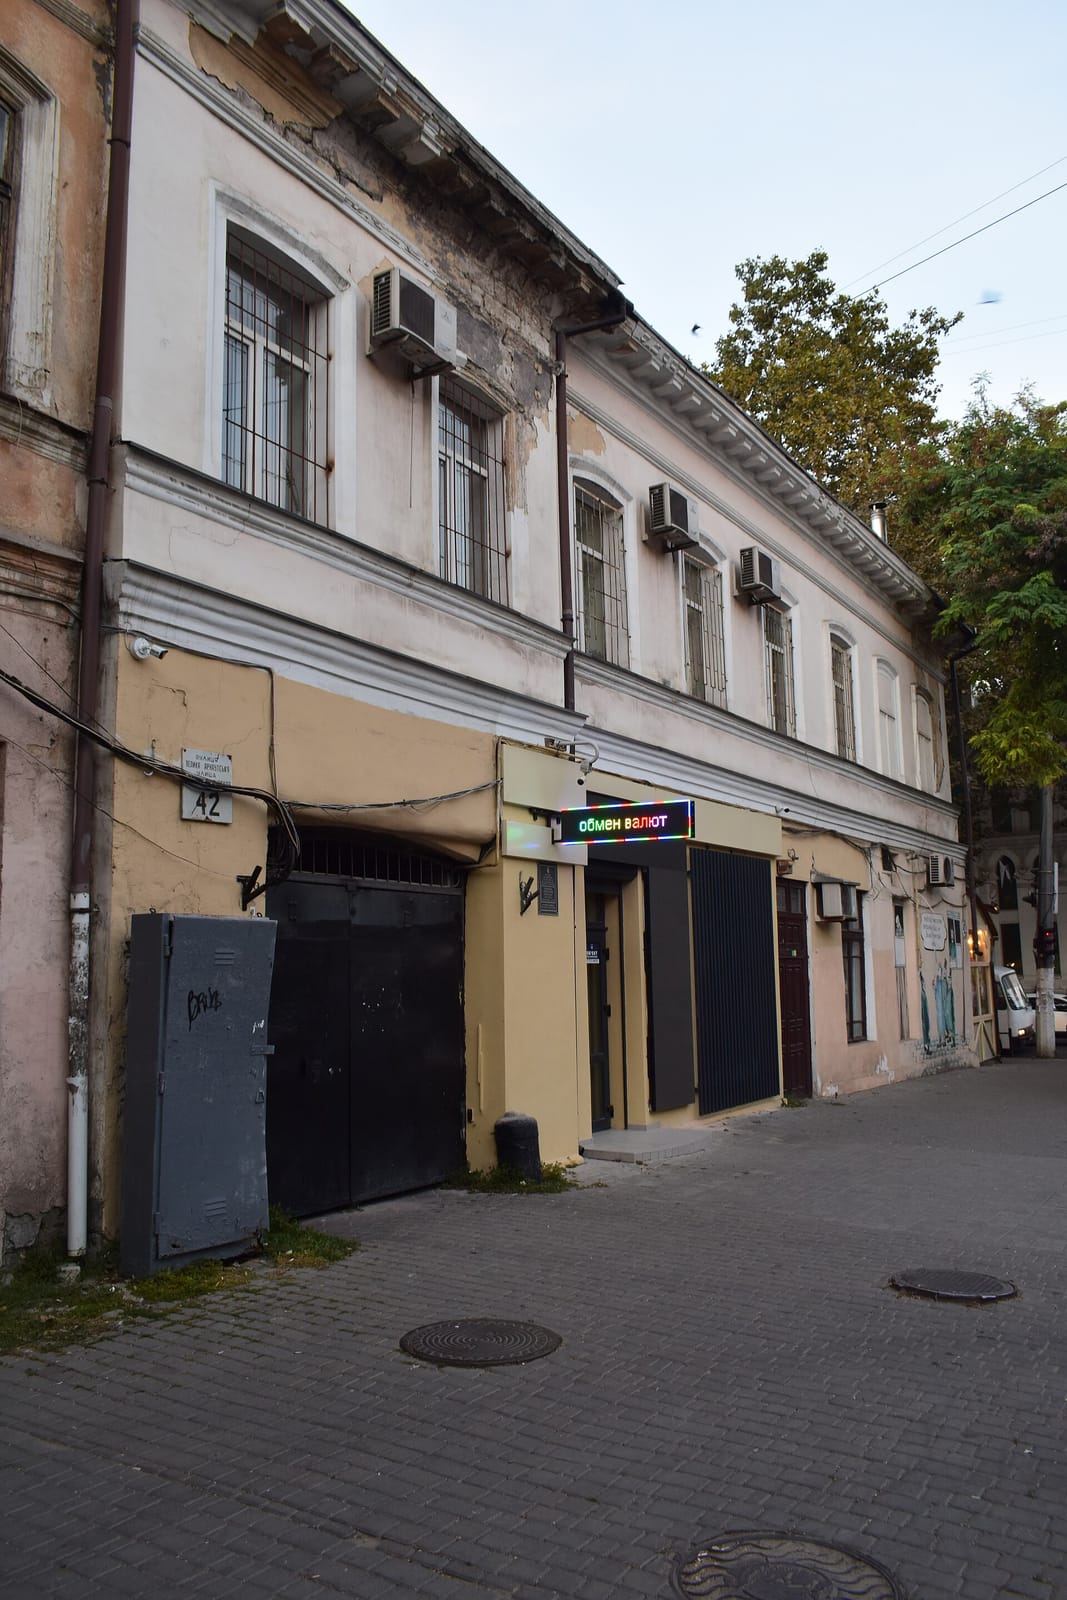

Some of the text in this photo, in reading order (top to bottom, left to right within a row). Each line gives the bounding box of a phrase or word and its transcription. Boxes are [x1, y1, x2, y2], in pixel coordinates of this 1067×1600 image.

[195, 791, 220, 817] 42
[579, 815, 668, 832] обмен валют
